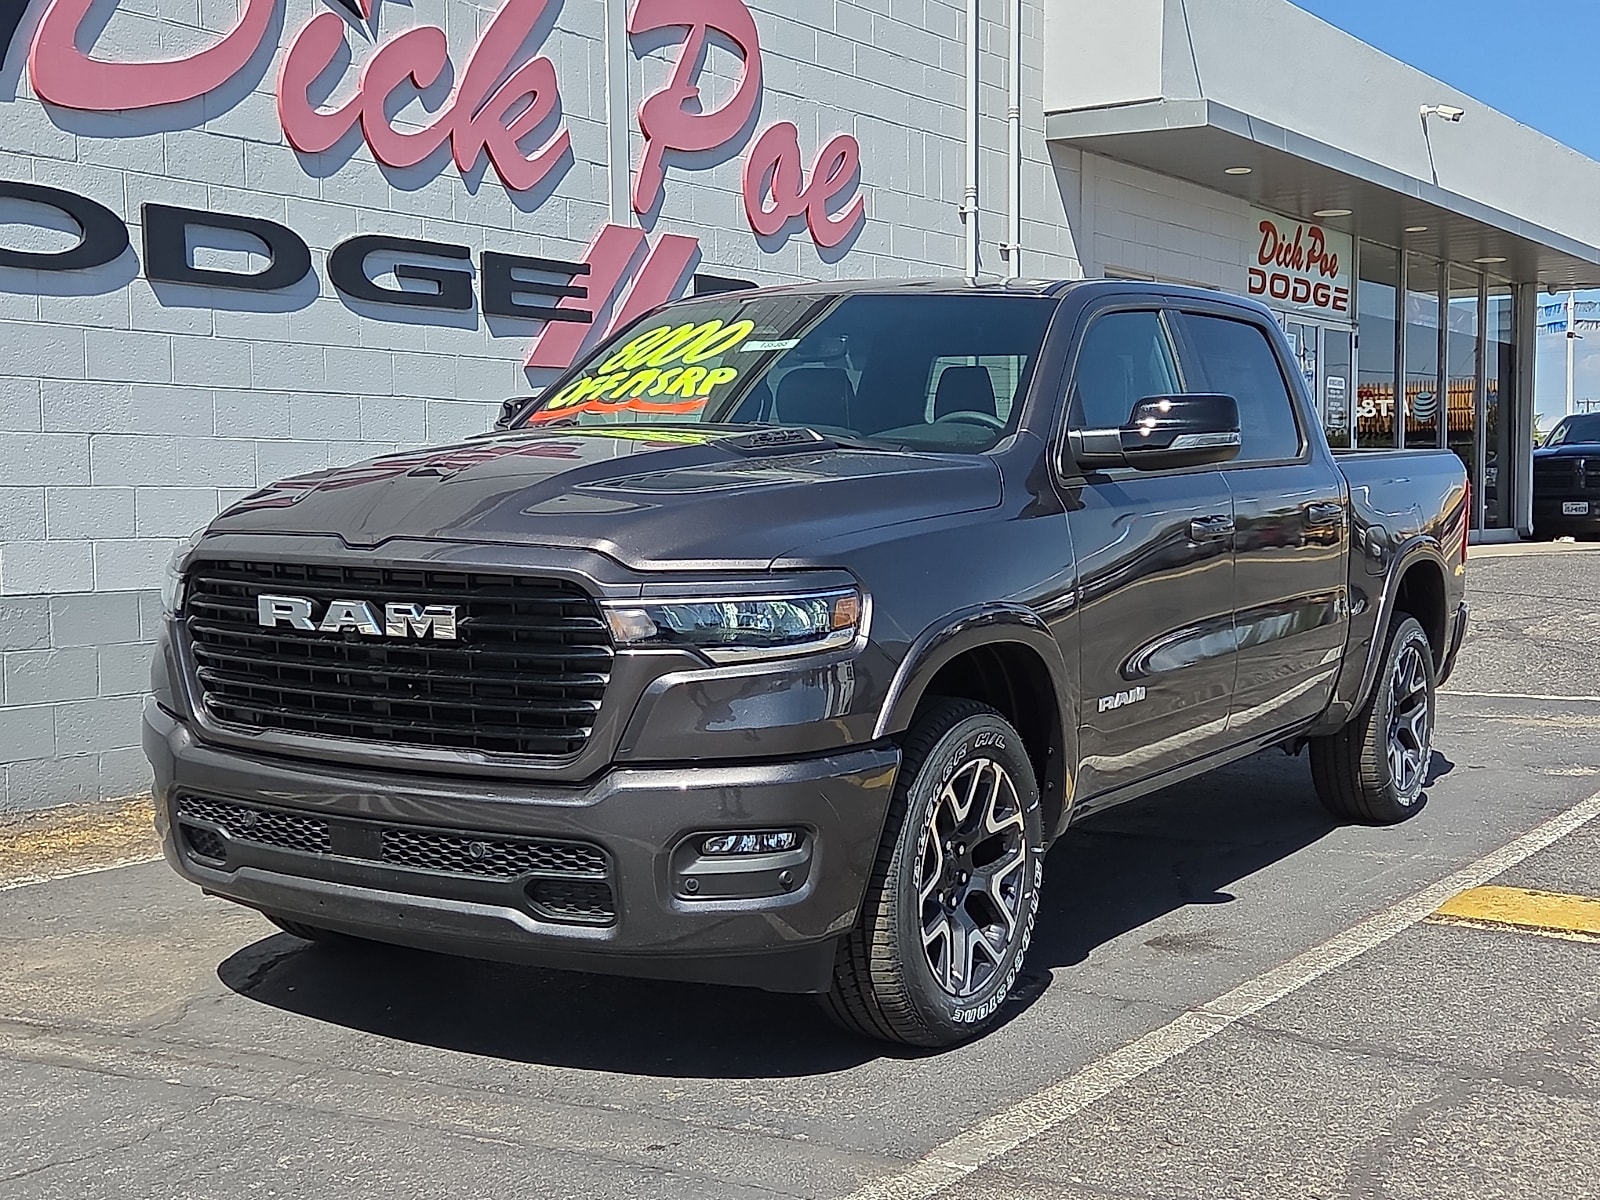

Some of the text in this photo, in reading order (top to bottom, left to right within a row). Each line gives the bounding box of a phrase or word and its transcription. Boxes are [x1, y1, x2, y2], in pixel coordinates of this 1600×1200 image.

[627, 0, 865, 248] Poe
[1257, 219, 1339, 279] Dick Poe
[1248, 267, 1349, 312] DODGE
[597, 319, 755, 375] 8000
[547, 366, 738, 409] OFF MSRP
[257, 594, 459, 640] RAM
[1098, 686, 1146, 713] RAM
[974, 732, 1006, 749] H/L
[952, 858, 1043, 1023] BRIDGESTONE
